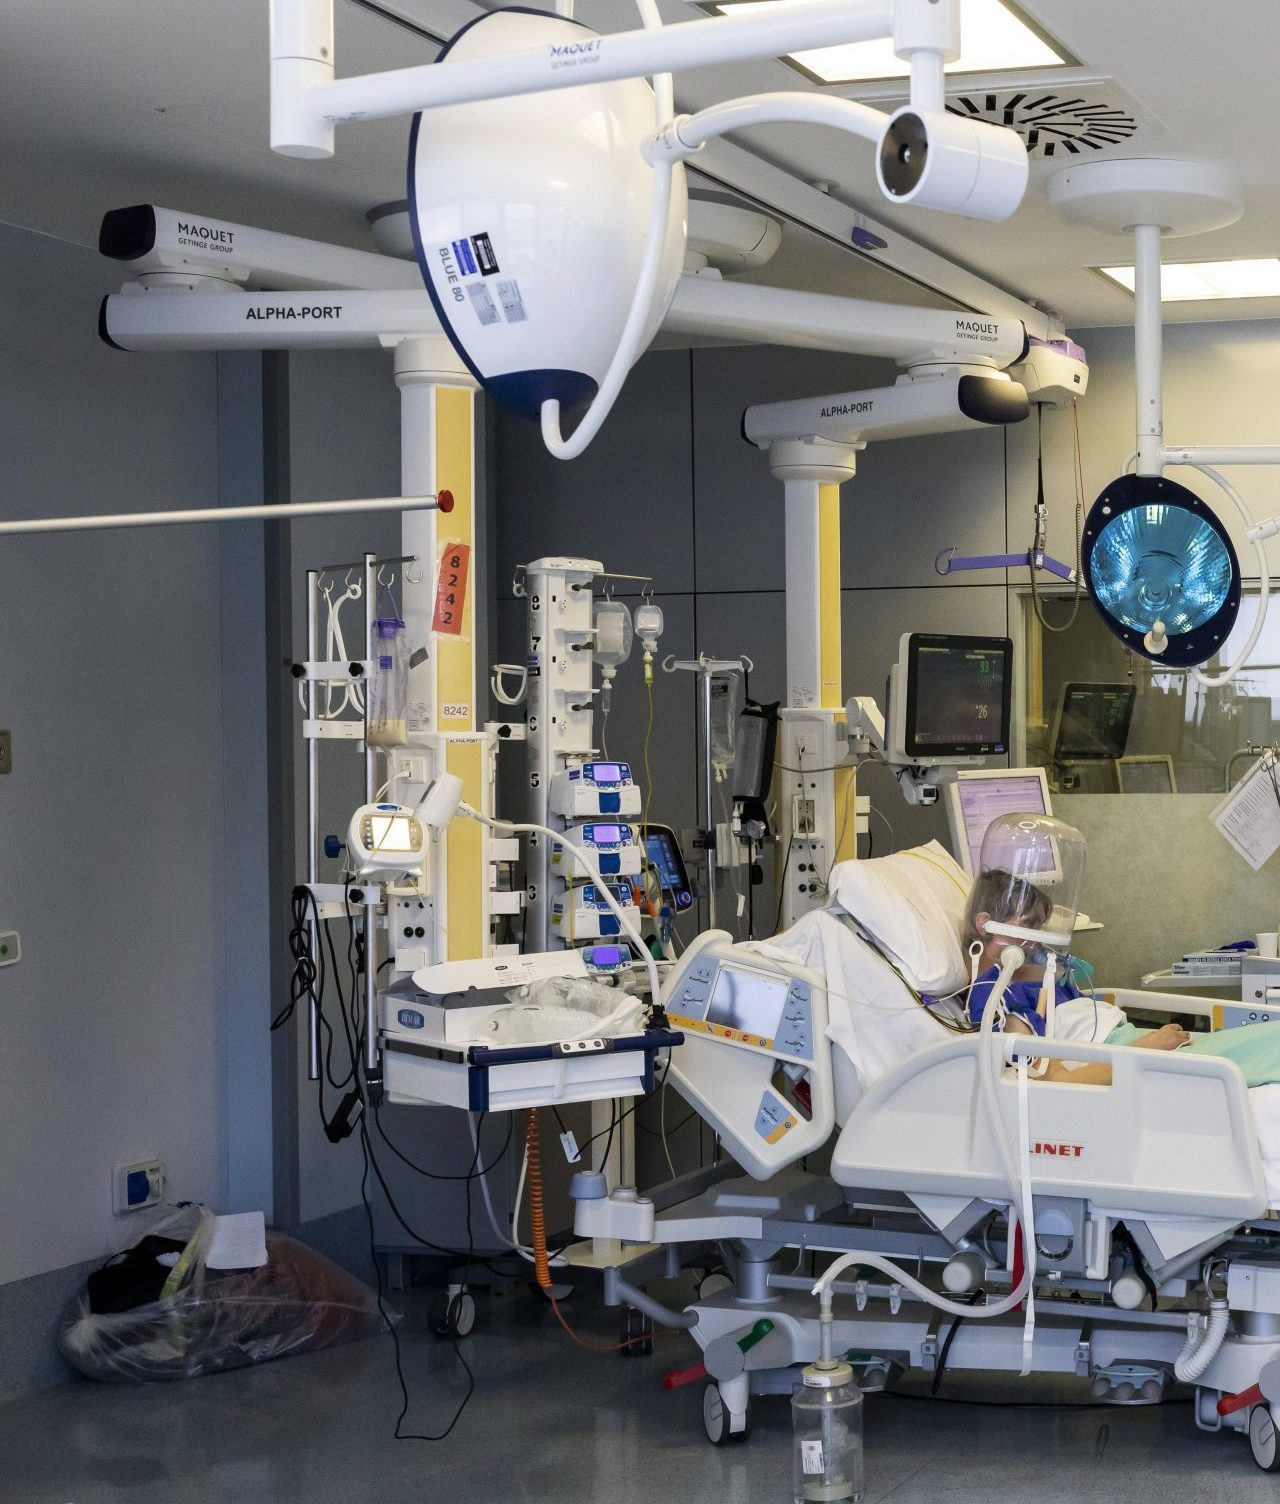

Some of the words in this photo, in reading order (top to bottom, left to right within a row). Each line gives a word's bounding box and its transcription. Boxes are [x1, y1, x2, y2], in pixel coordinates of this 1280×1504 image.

[551, 40, 601, 57] MAQUET
[178, 222, 234, 243] MAQUET
[178, 238, 208, 249] GETINGE
[210, 243, 234, 254] GROUP
[439, 248, 460, 284] BLUE
[452, 286, 465, 302] 80
[246, 306, 342, 320] ALPHA-PORT
[956, 320, 999, 334] MAQUET
[820, 401, 873, 418] ALPHA-PORT
[443, 706, 468, 716] 8242
[1029, 1143, 1084, 1157] INET
